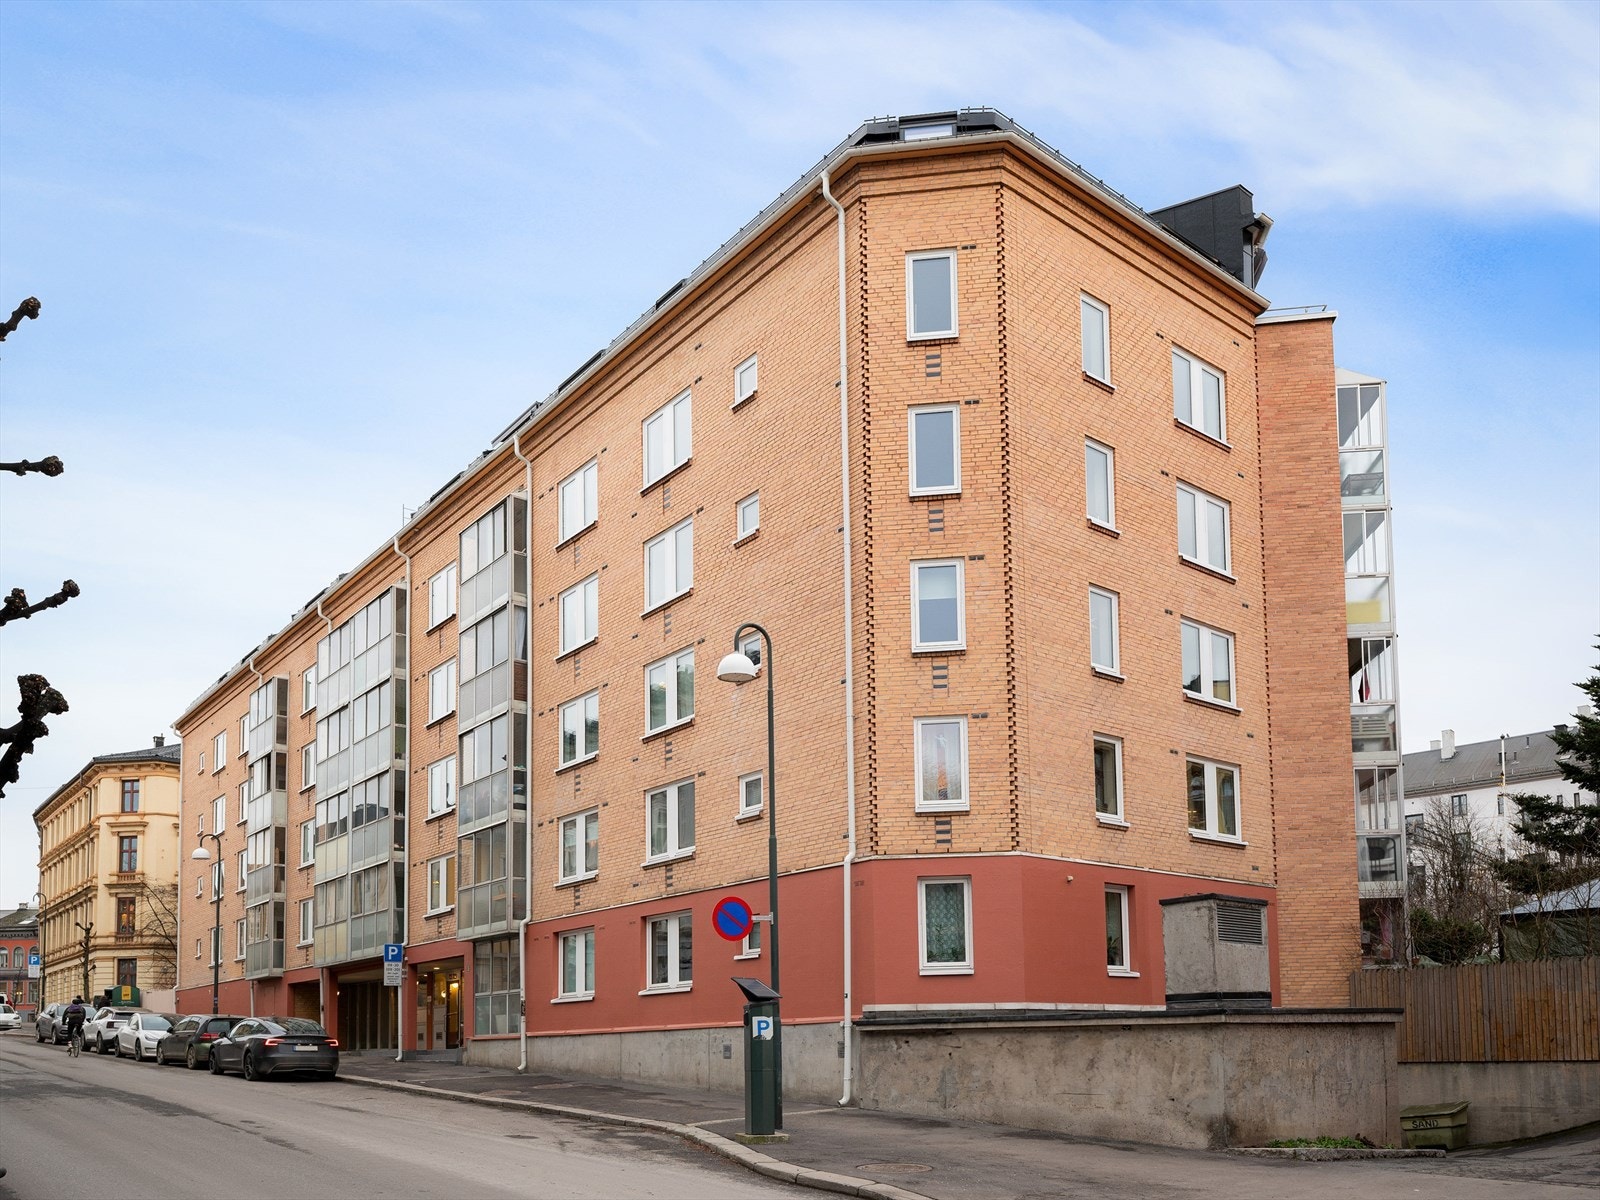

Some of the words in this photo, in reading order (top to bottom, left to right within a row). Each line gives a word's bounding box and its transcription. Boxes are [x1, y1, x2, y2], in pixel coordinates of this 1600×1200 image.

[388, 946, 398, 960] P
[31, 956, 38, 964] P
[757, 1020, 770, 1036] P
[1412, 1120, 1438, 1128] SAND
